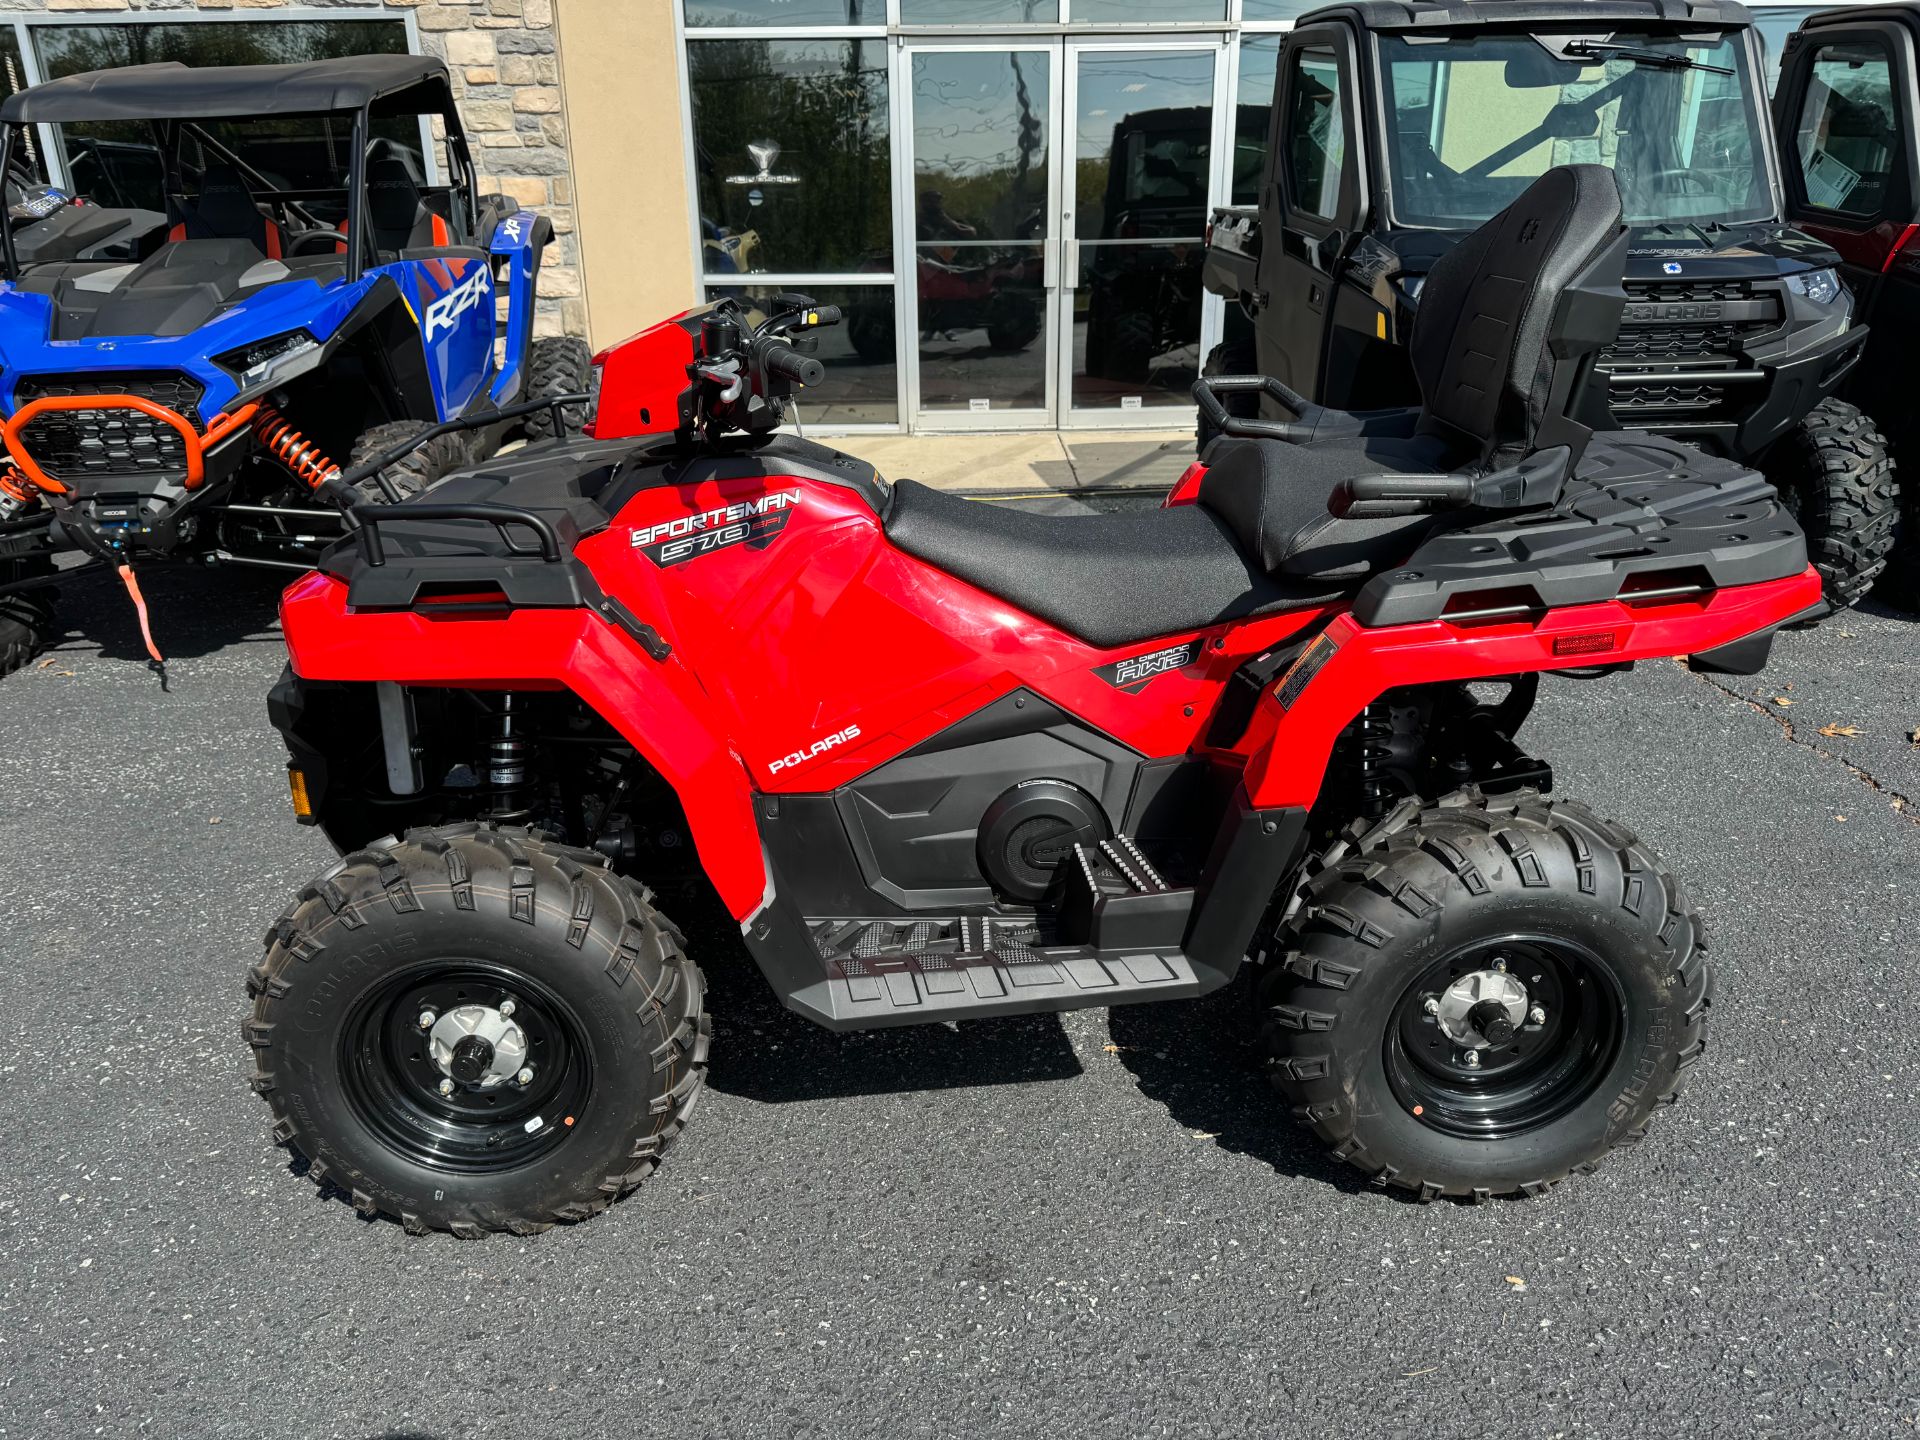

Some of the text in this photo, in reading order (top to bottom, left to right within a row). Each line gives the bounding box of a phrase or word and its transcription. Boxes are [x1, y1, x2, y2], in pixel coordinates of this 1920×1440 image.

[504, 218, 521, 243] XP
[1627, 248, 1713, 256] ANGER
[425, 263, 490, 344] RZR
[1621, 304, 1721, 320] POLARIS
[631, 488, 801, 547] SPORTSMAN
[661, 516, 781, 562] 570 EFI
[1116, 644, 1190, 668] ON DEMAND
[1116, 651, 1190, 683] AWD
[768, 724, 861, 775] POLARIS
[1606, 1006, 1668, 1121] POLARIS
